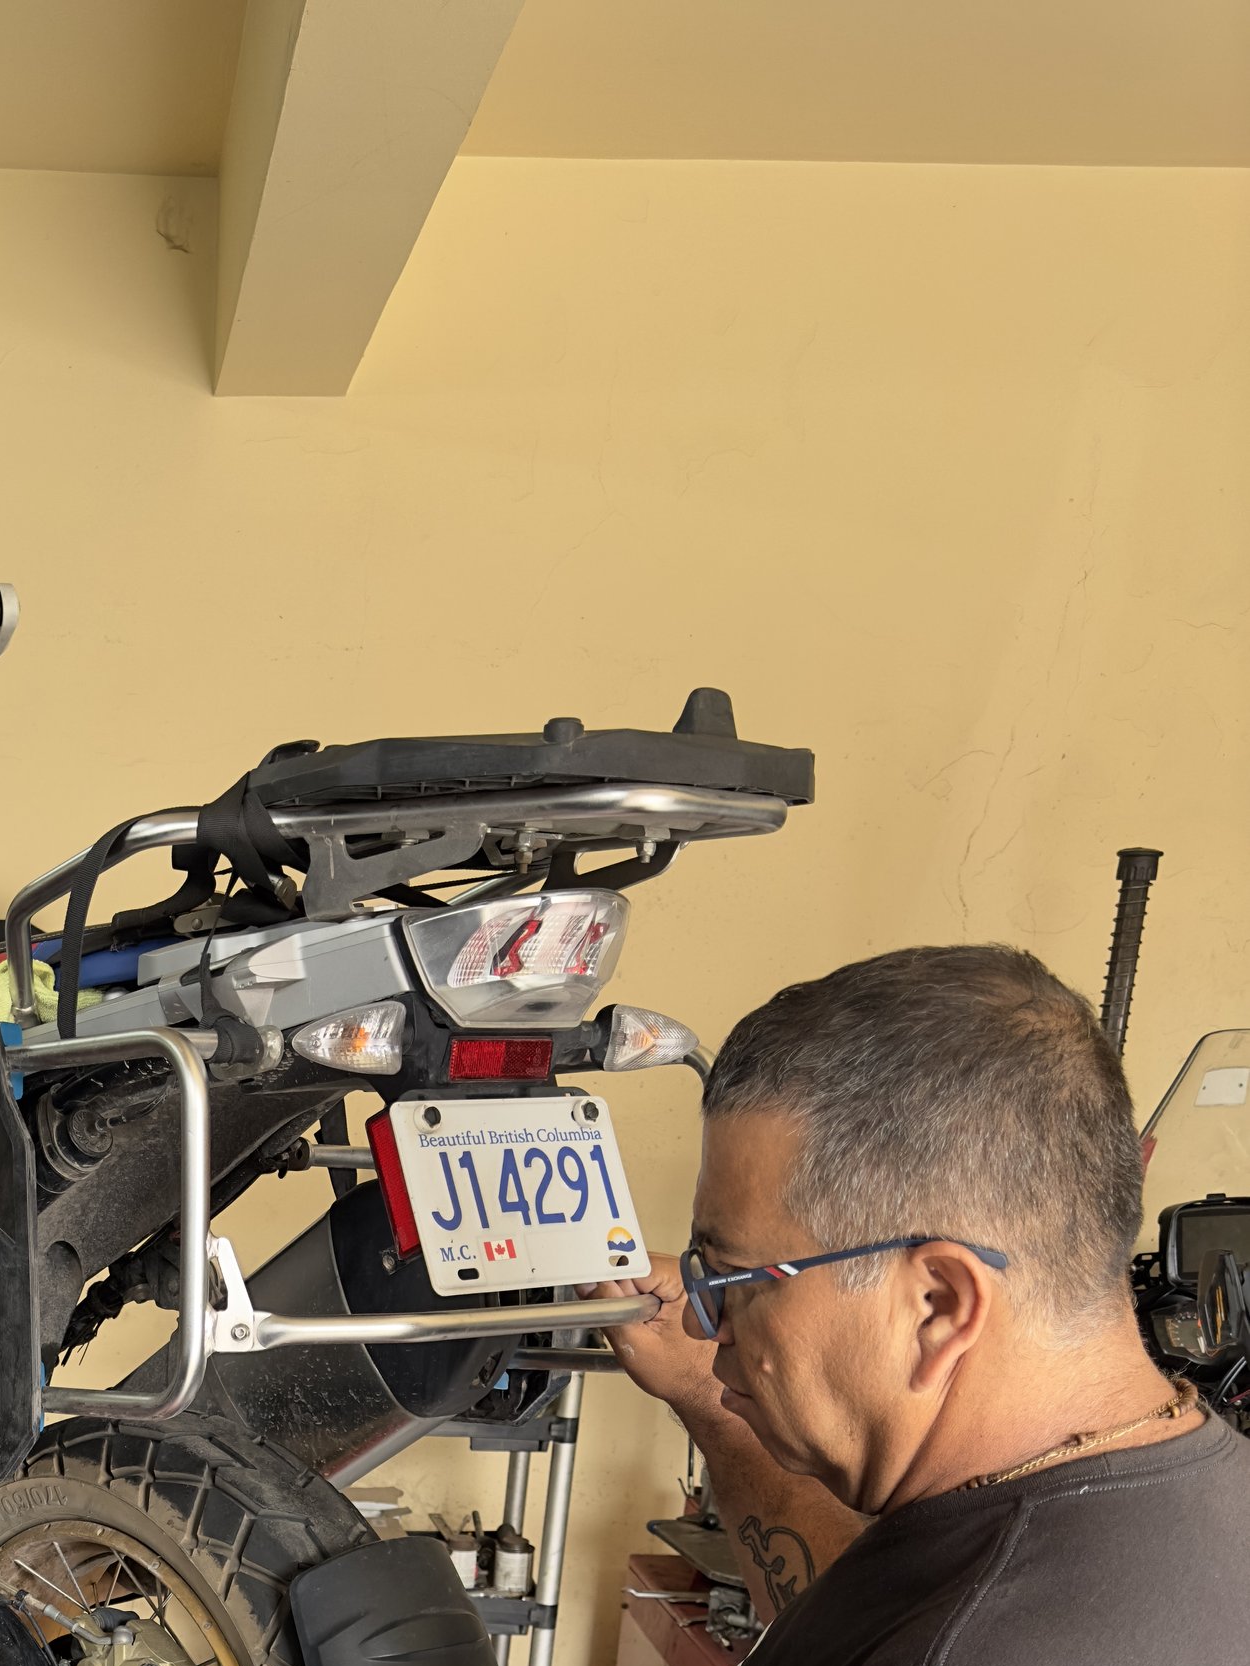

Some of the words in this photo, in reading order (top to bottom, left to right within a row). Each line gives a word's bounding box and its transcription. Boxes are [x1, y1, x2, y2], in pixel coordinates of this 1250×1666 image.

[418, 1130, 486, 1148] Beautiful
[488, 1128, 535, 1145] British
[536, 1127, 603, 1143] Columbia
[431, 1144, 620, 1231] J14291
[439, 1244, 477, 1262] M.C.
